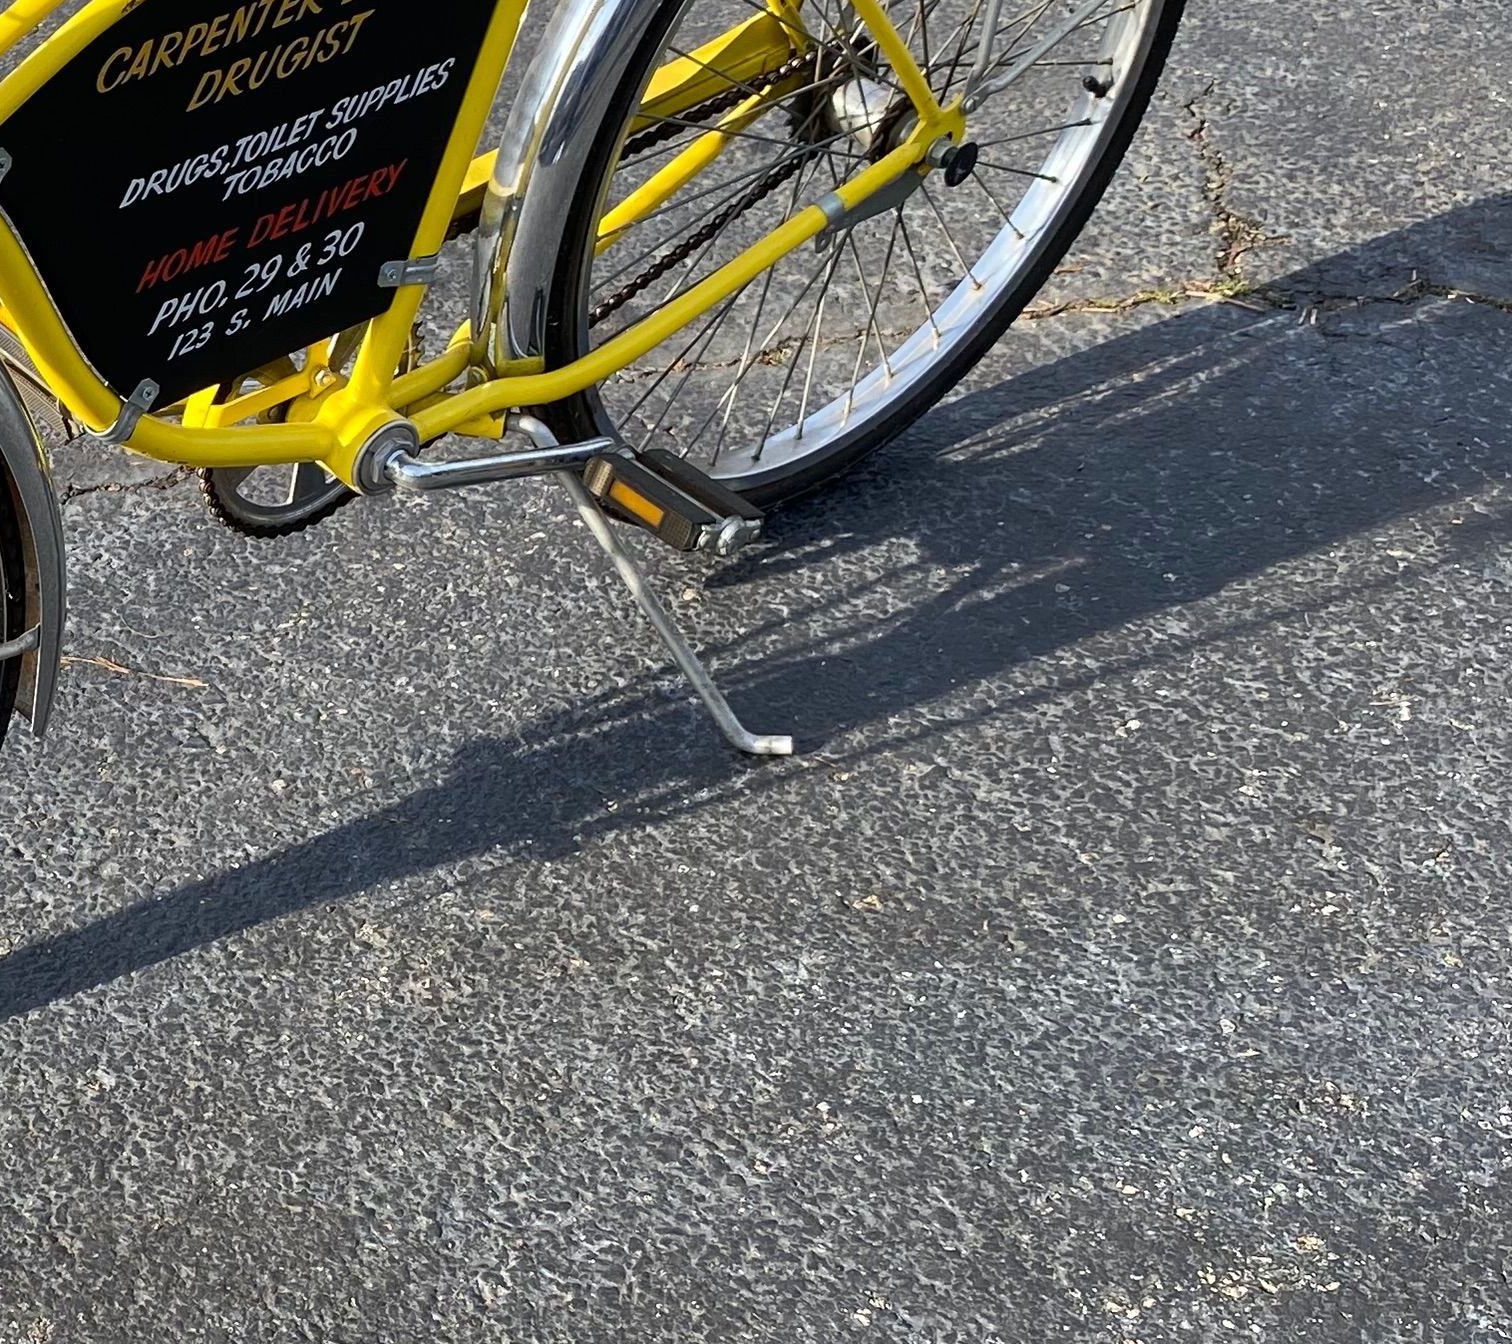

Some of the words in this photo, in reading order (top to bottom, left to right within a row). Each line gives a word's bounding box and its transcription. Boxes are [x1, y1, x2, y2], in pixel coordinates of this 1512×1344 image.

[185, 8, 376, 113] DRUGIST
[324, 56, 456, 130] SUPPLIES
[221, 127, 358, 202] TOBACCO
[135, 227, 240, 294] HOME
[246, 158, 408, 249] DELIVERY
[234, 253, 283, 300] 29
[286, 242, 312, 278] &
[316, 221, 365, 266] 30
[167, 320, 215, 362] 123
[224, 308, 252, 336] S.
[261, 267, 343, 322] MAIN
